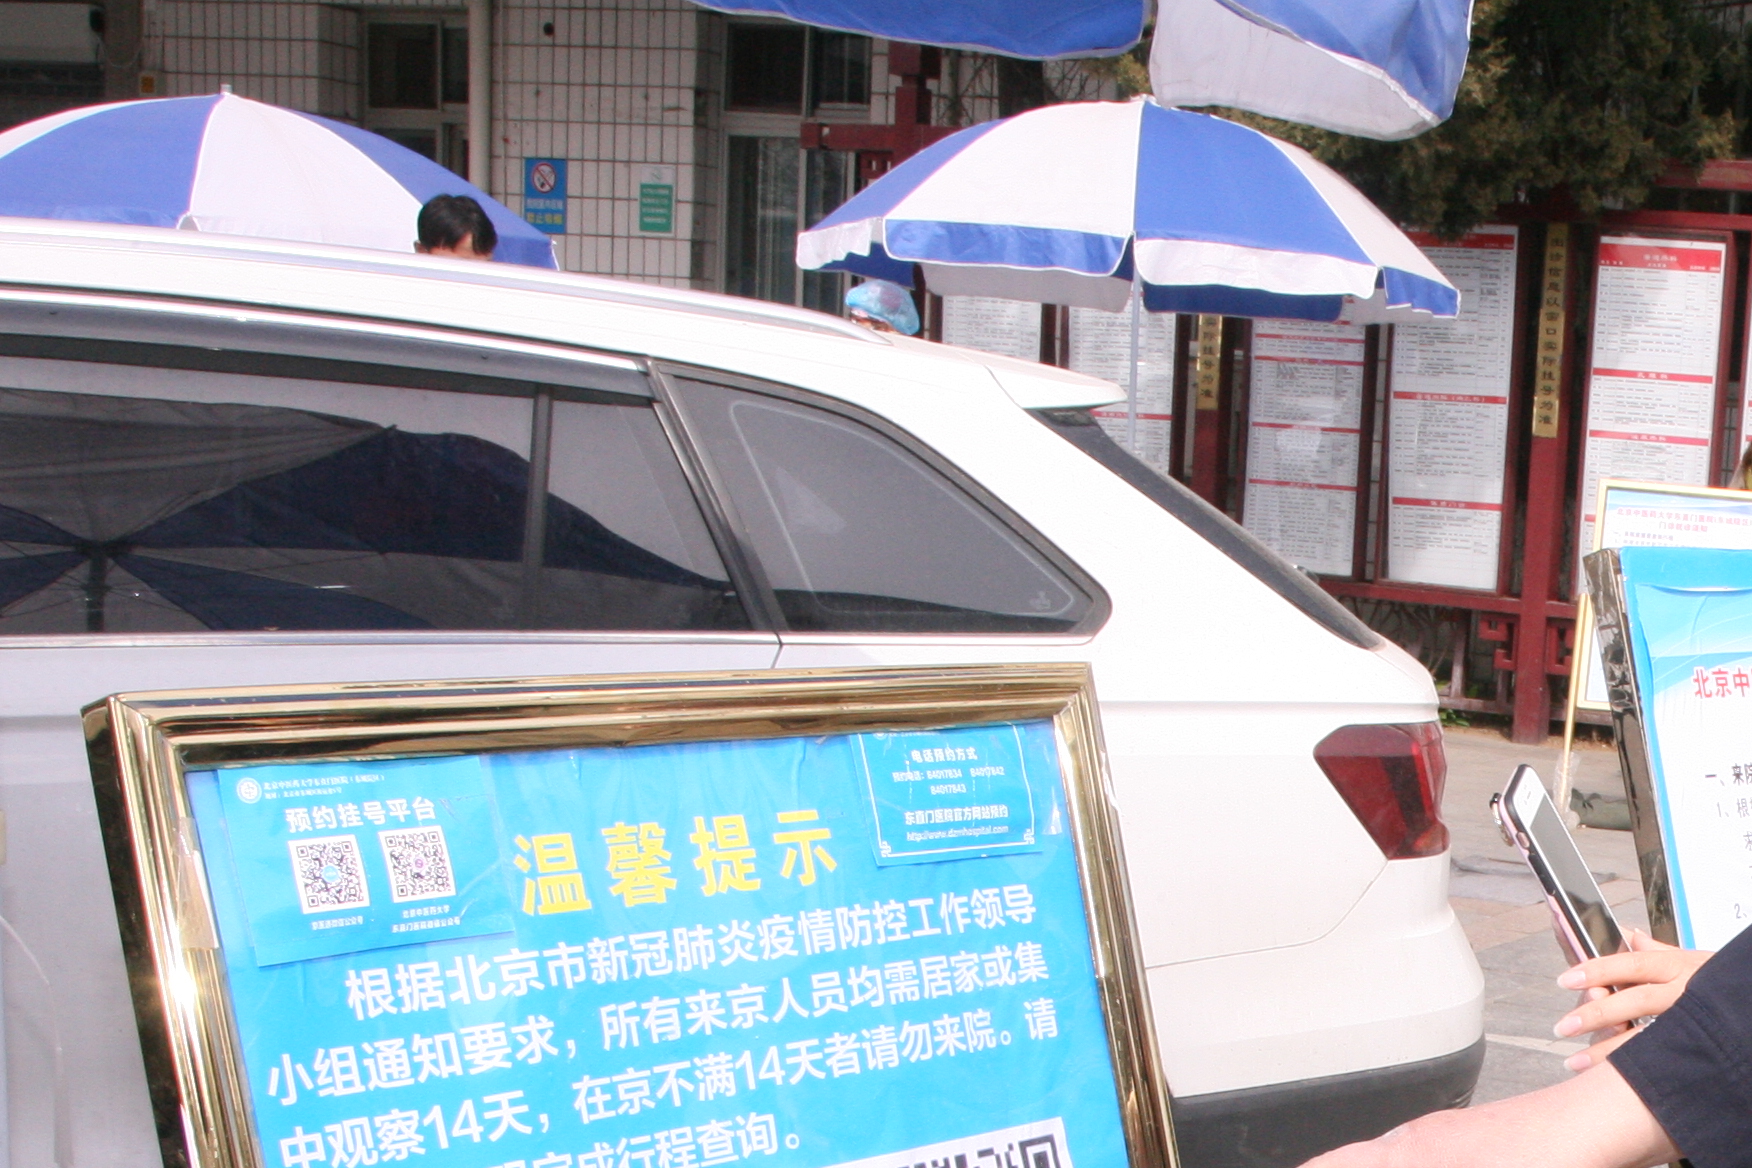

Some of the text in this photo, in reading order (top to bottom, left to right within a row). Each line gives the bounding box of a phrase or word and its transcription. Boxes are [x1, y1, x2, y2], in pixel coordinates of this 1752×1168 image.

[911, 746, 978, 764] 电话预约方式
[284, 797, 437, 834] 预约挂号平台
[513, 808, 839, 921] 温馨提示
[346, 884, 1037, 1022] 根据北京市新冠肺炎疫情防控工作领导
[265, 942, 1050, 1106] 小组通知要求，所有来京人员均需居家或集
